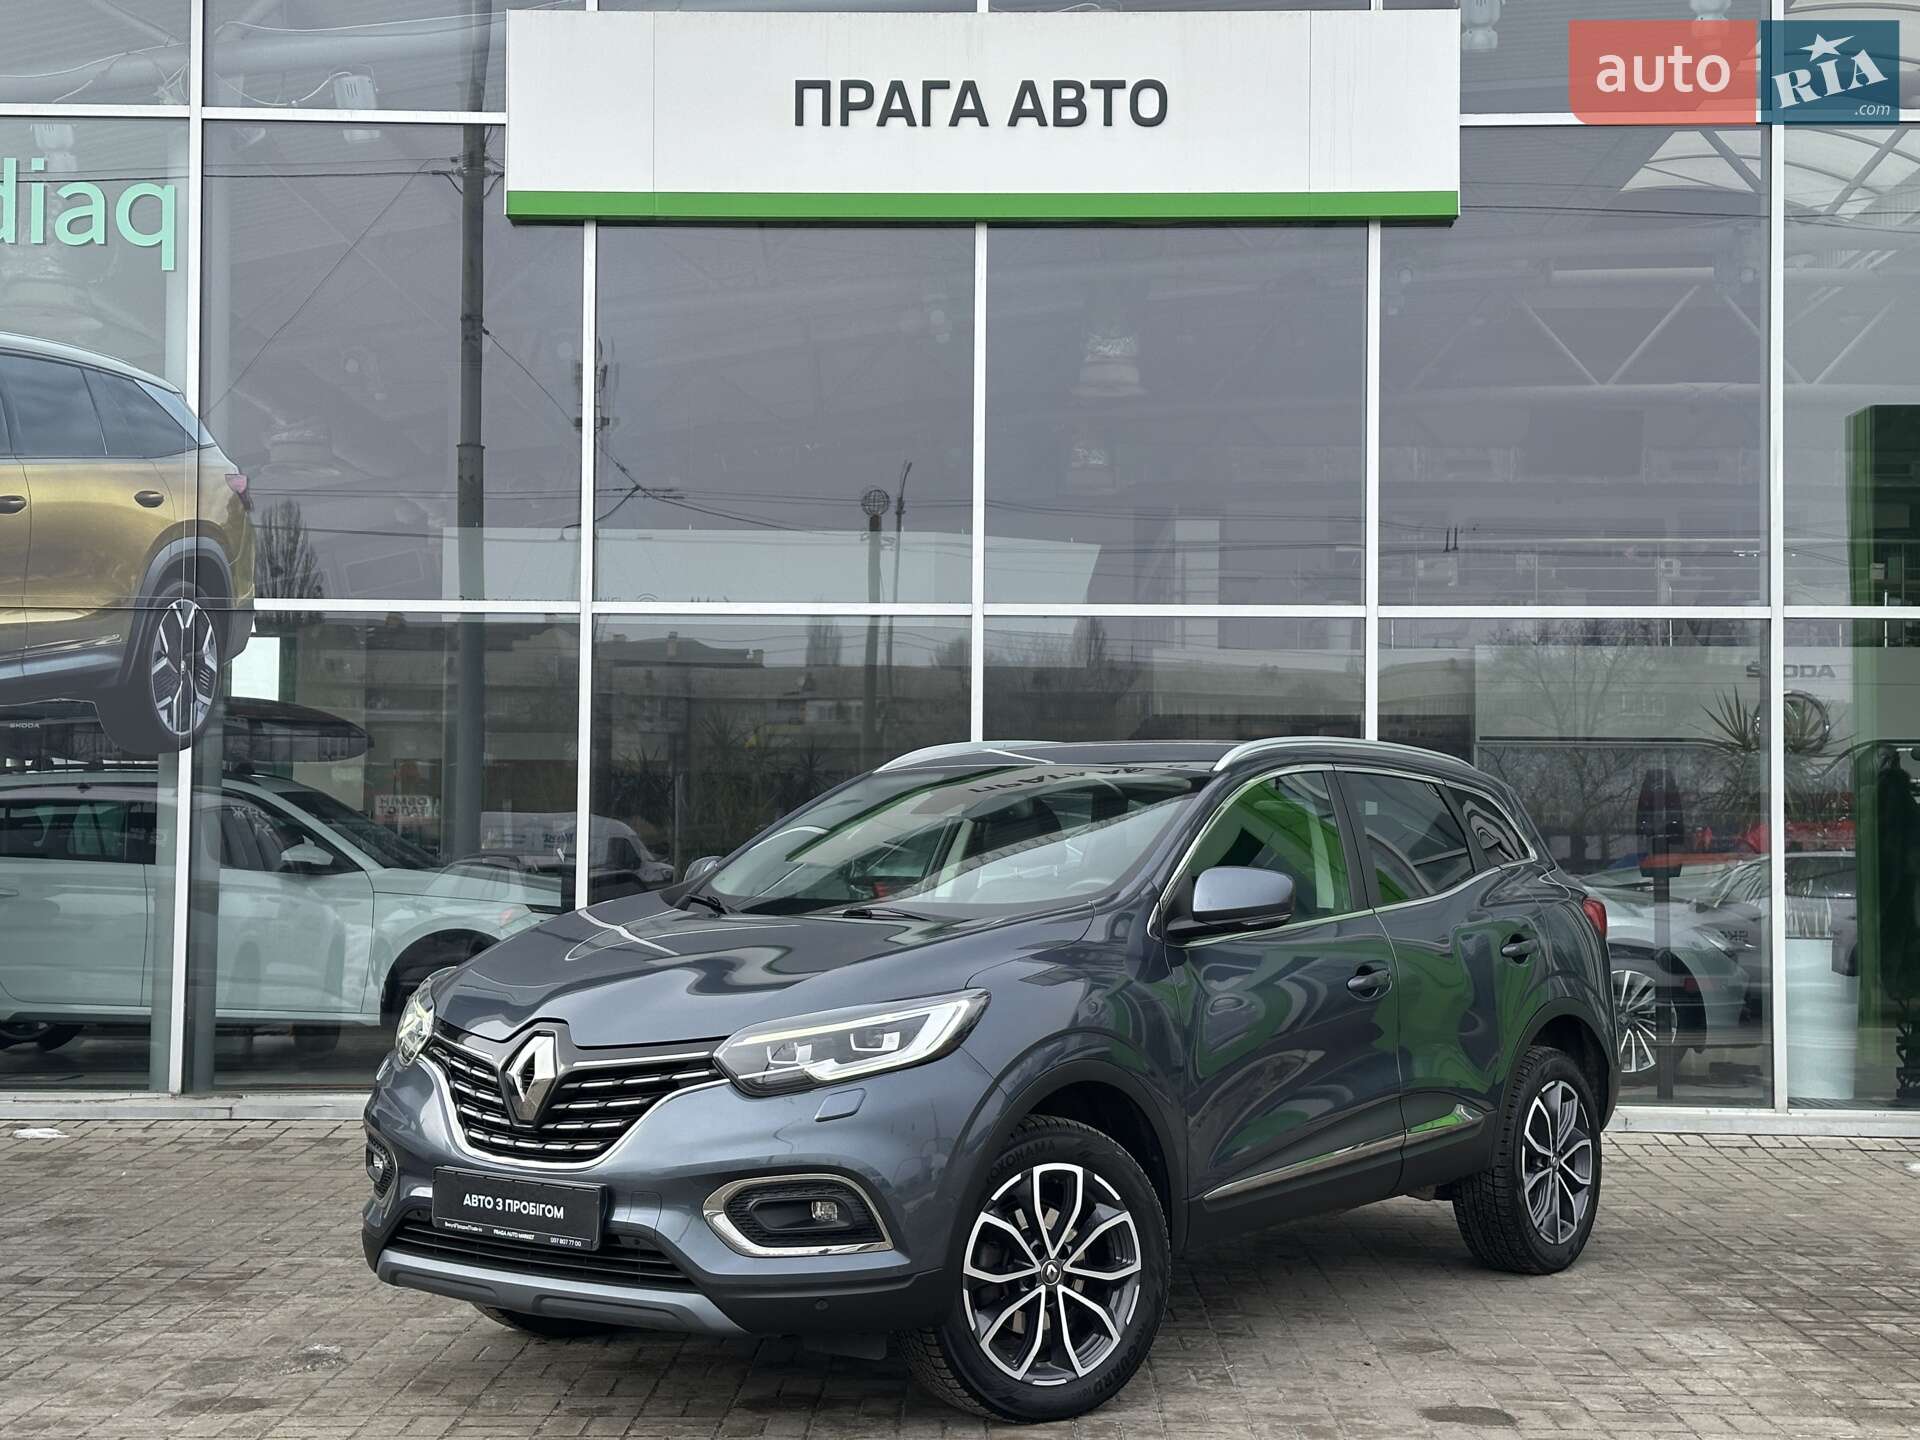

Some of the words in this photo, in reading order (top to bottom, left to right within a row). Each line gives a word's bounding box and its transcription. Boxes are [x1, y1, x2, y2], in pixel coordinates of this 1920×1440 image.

[794, 79, 990, 127] ПРАГА
[1007, 78, 1169, 128] АВТО
[0, 157, 176, 272] iaq
[1746, 661, 1836, 678] ŠODA
[463, 1193, 494, 1209] АВТО
[495, 1197, 503, 1211] З
[505, 1199, 564, 1220] ПРОБІГОМ
